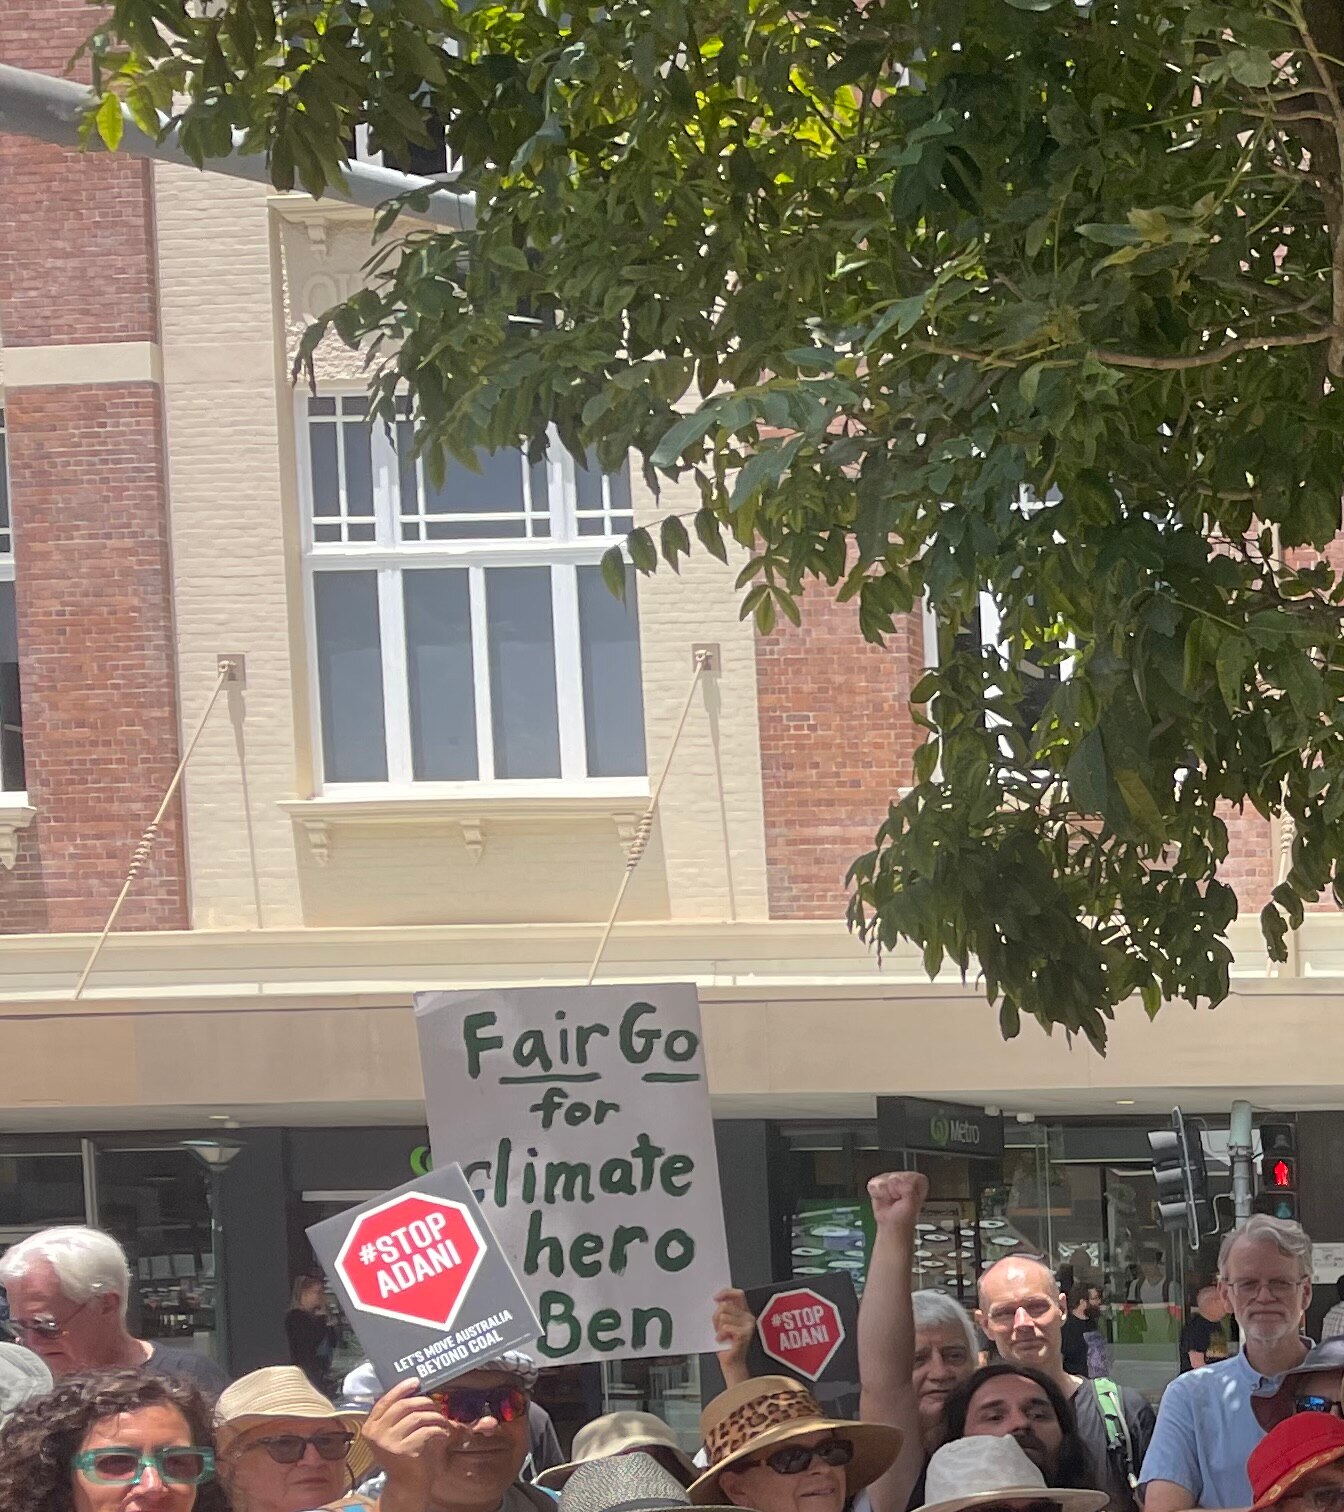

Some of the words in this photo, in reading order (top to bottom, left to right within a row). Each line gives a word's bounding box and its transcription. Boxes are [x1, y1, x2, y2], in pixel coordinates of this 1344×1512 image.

[463, 1009, 609, 1079] Fair
[619, 1001, 698, 1064] Go
[530, 1087, 620, 1129] for
[950, 1119, 980, 1145] Metro
[464, 1133, 694, 1208] climate
[359, 1212, 447, 1265] #STOP
[523, 1210, 695, 1277] hero
[376, 1239, 462, 1299] ADANI
[393, 1348, 425, 1373] LET'S
[424, 1335, 456, 1361] MOVE
[455, 1310, 513, 1345] AUSTRALIA
[536, 1290, 672, 1358] Ben
[771, 1305, 824, 1330] #STOP
[780, 1324, 830, 1352] ADANI
[416, 1343, 470, 1379] BEYOND
[468, 1329, 504, 1358] COAL
